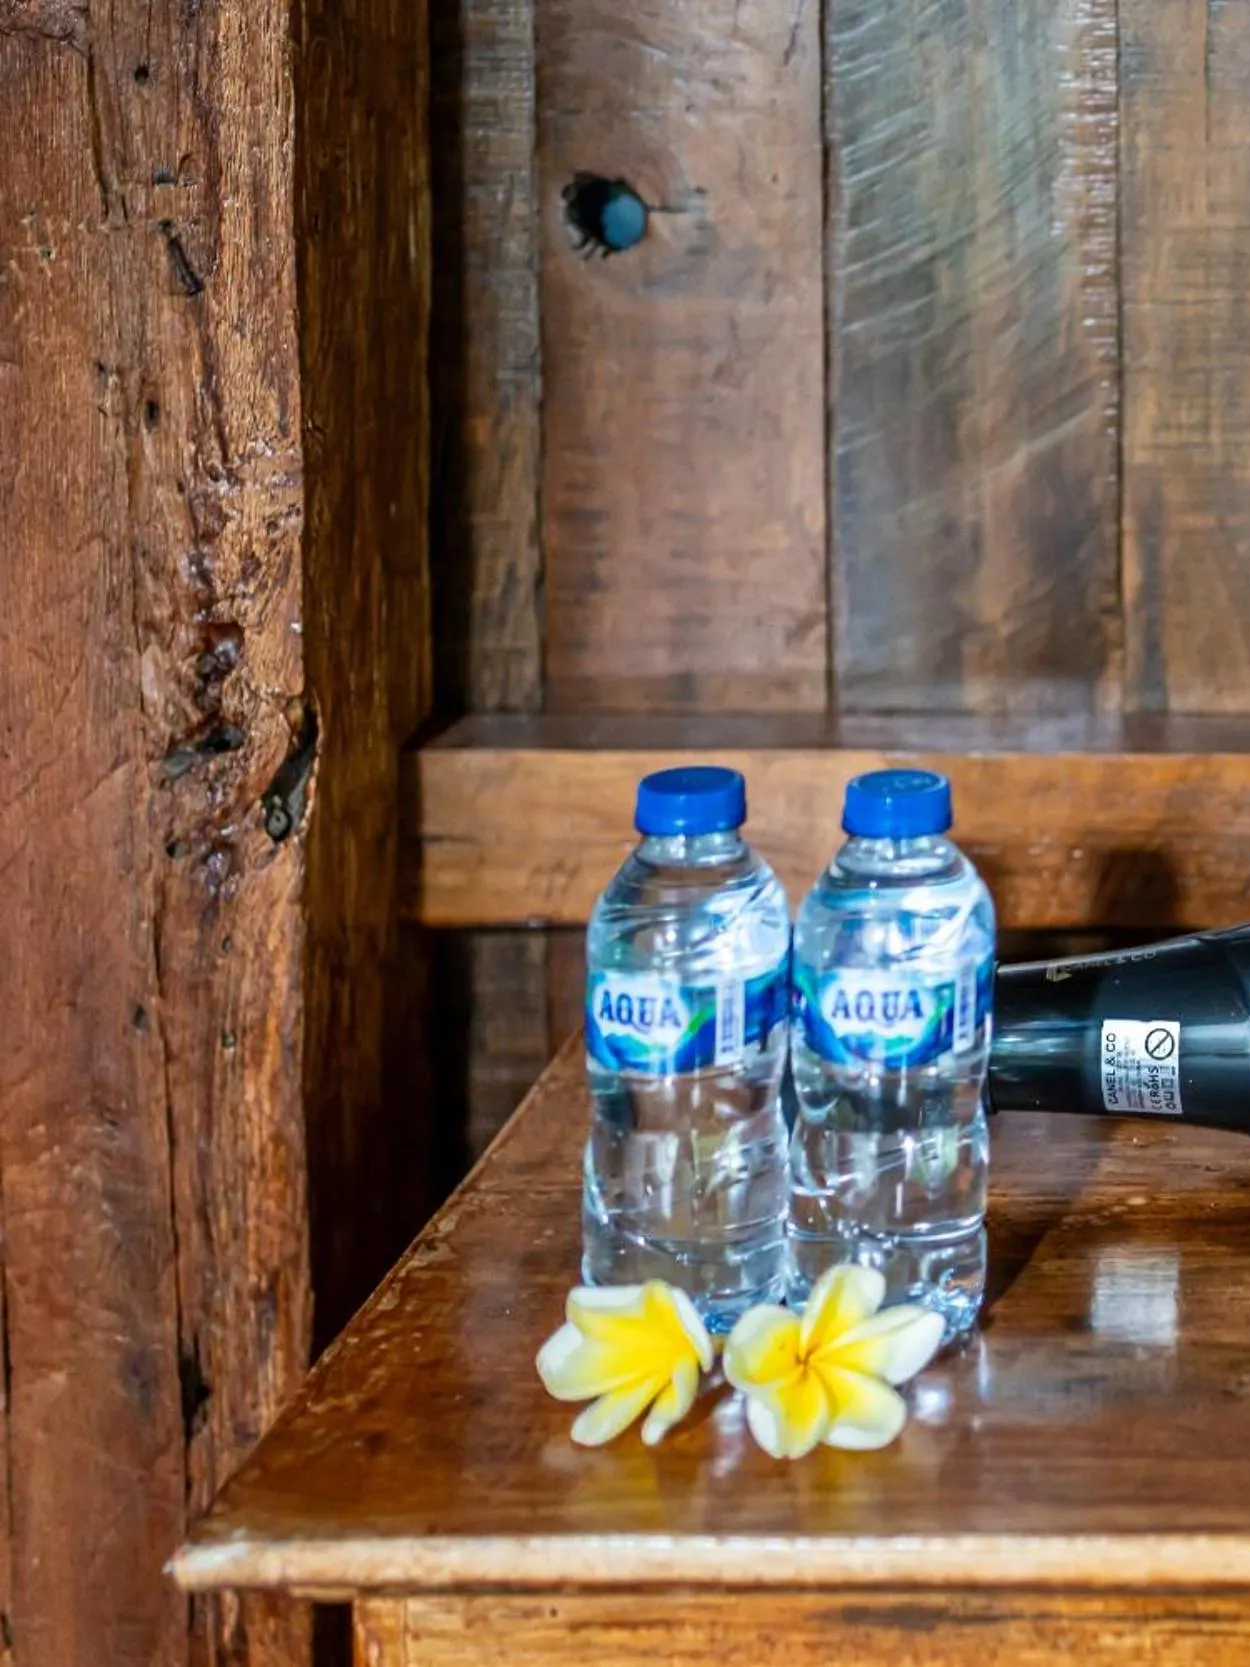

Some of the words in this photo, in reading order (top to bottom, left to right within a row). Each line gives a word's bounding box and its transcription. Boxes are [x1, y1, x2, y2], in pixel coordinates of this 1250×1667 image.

[600, 990, 683, 1034] AQUA
[831, 989, 924, 1027] AQUA
[1106, 1033, 1116, 1053] CO
[1104, 1056, 1116, 1067] &
